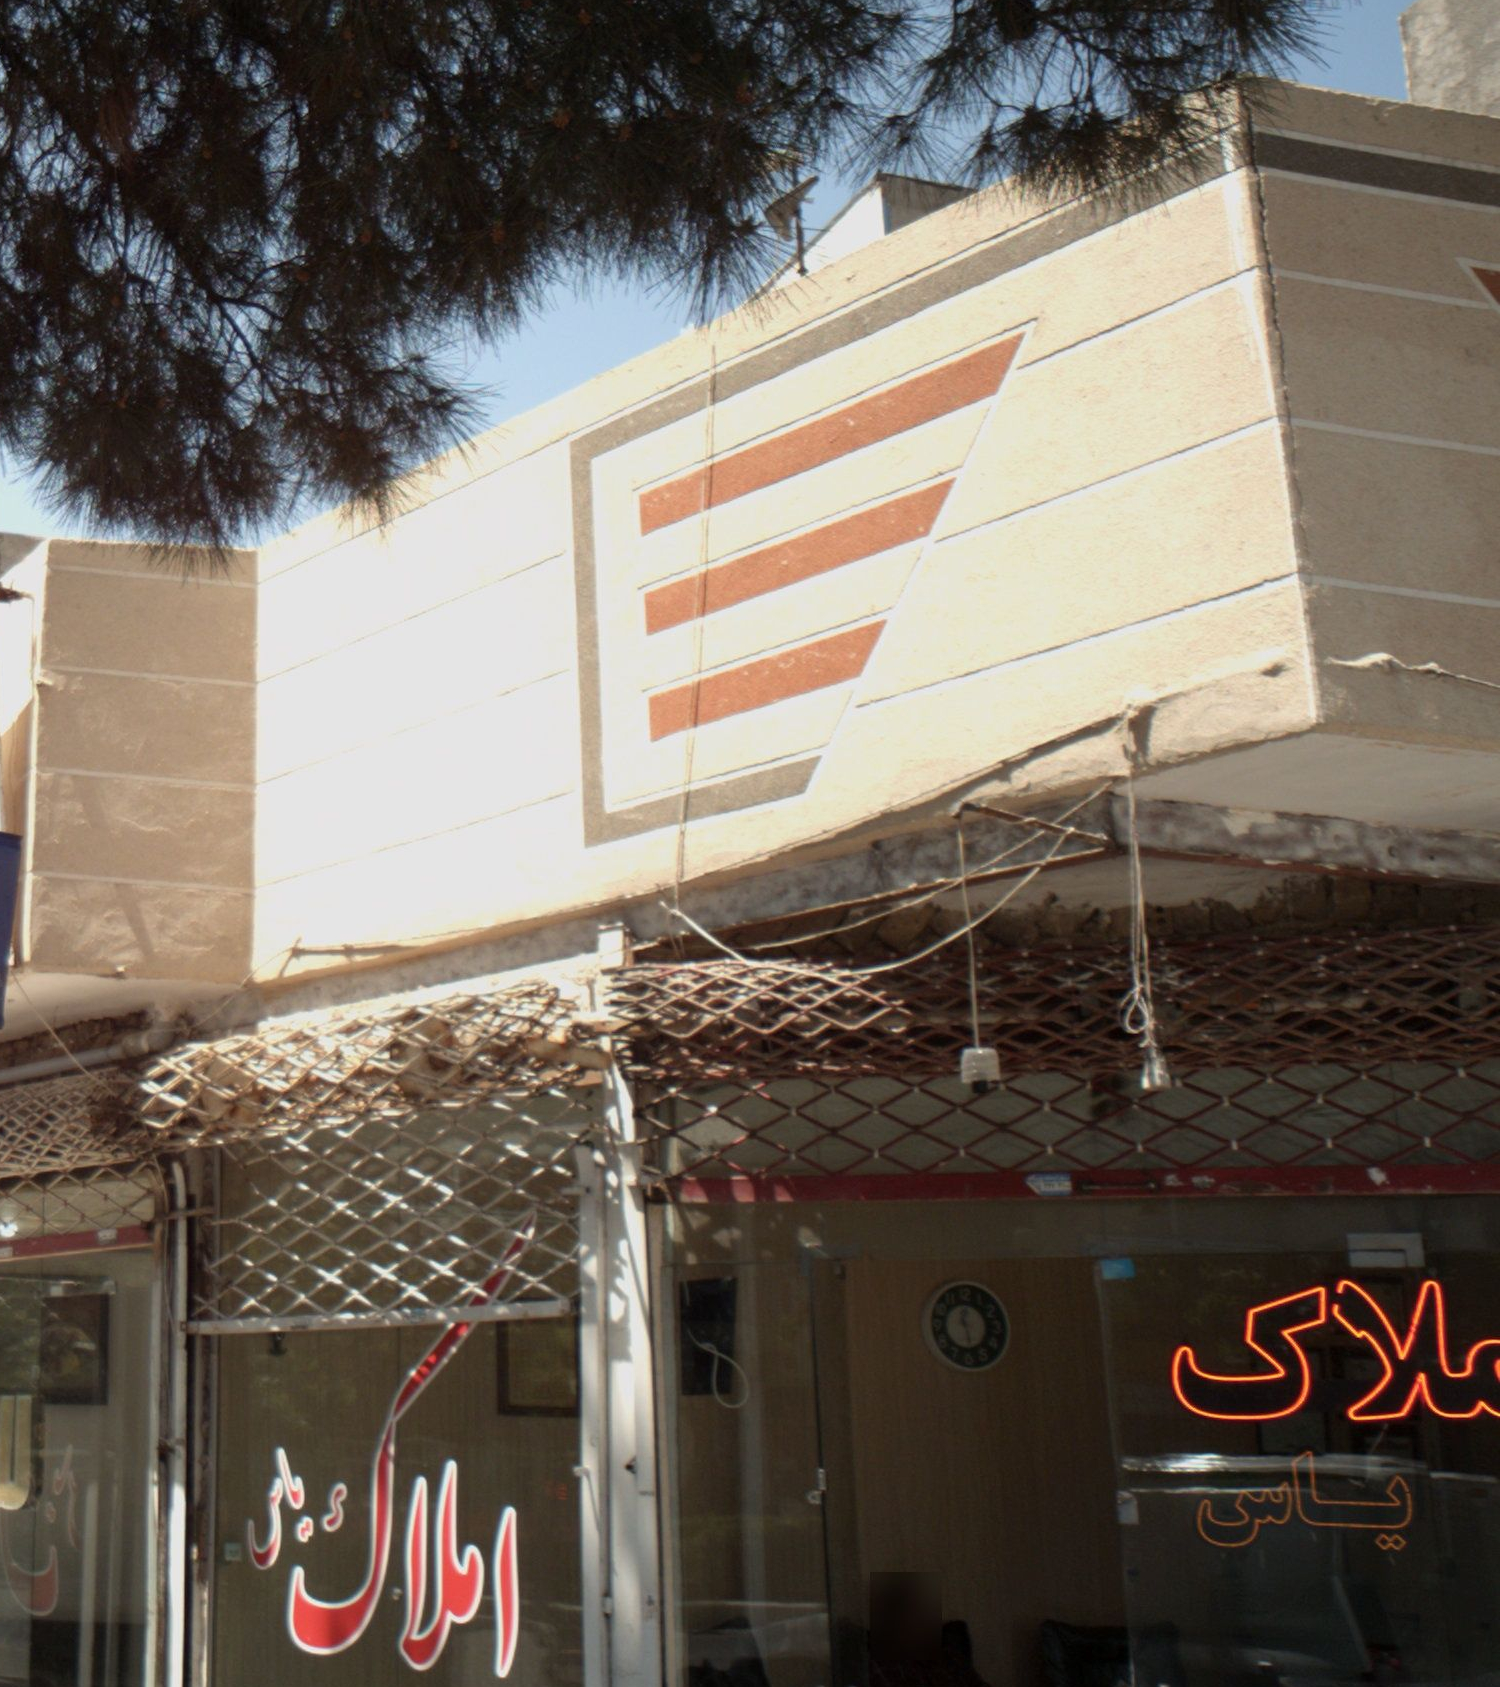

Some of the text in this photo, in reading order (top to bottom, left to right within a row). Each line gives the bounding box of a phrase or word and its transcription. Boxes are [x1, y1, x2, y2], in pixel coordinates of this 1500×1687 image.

[1171, 1280, 1500, 1421] ملاک
[287, 1211, 535, 1678] املاک
[1197, 1451, 1412, 1550] یاس
